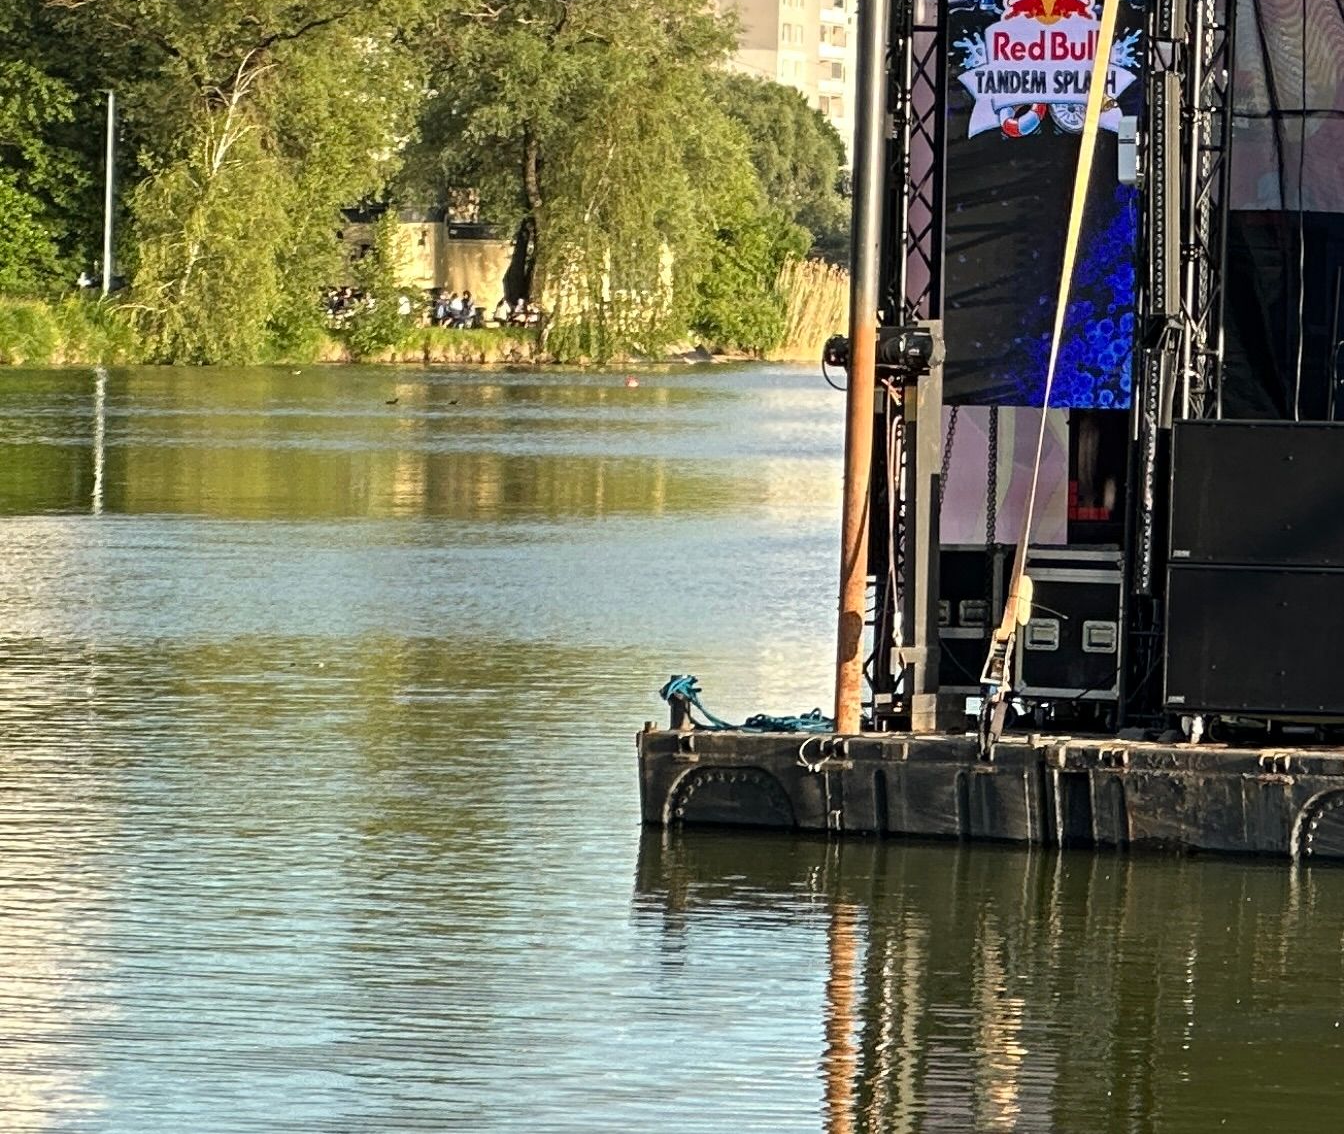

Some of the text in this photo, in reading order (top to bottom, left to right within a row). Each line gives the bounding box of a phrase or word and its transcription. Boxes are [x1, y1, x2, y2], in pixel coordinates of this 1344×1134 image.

[993, 30, 1046, 61] Red
[975, 69, 1117, 95] TANDEM SPLAH
